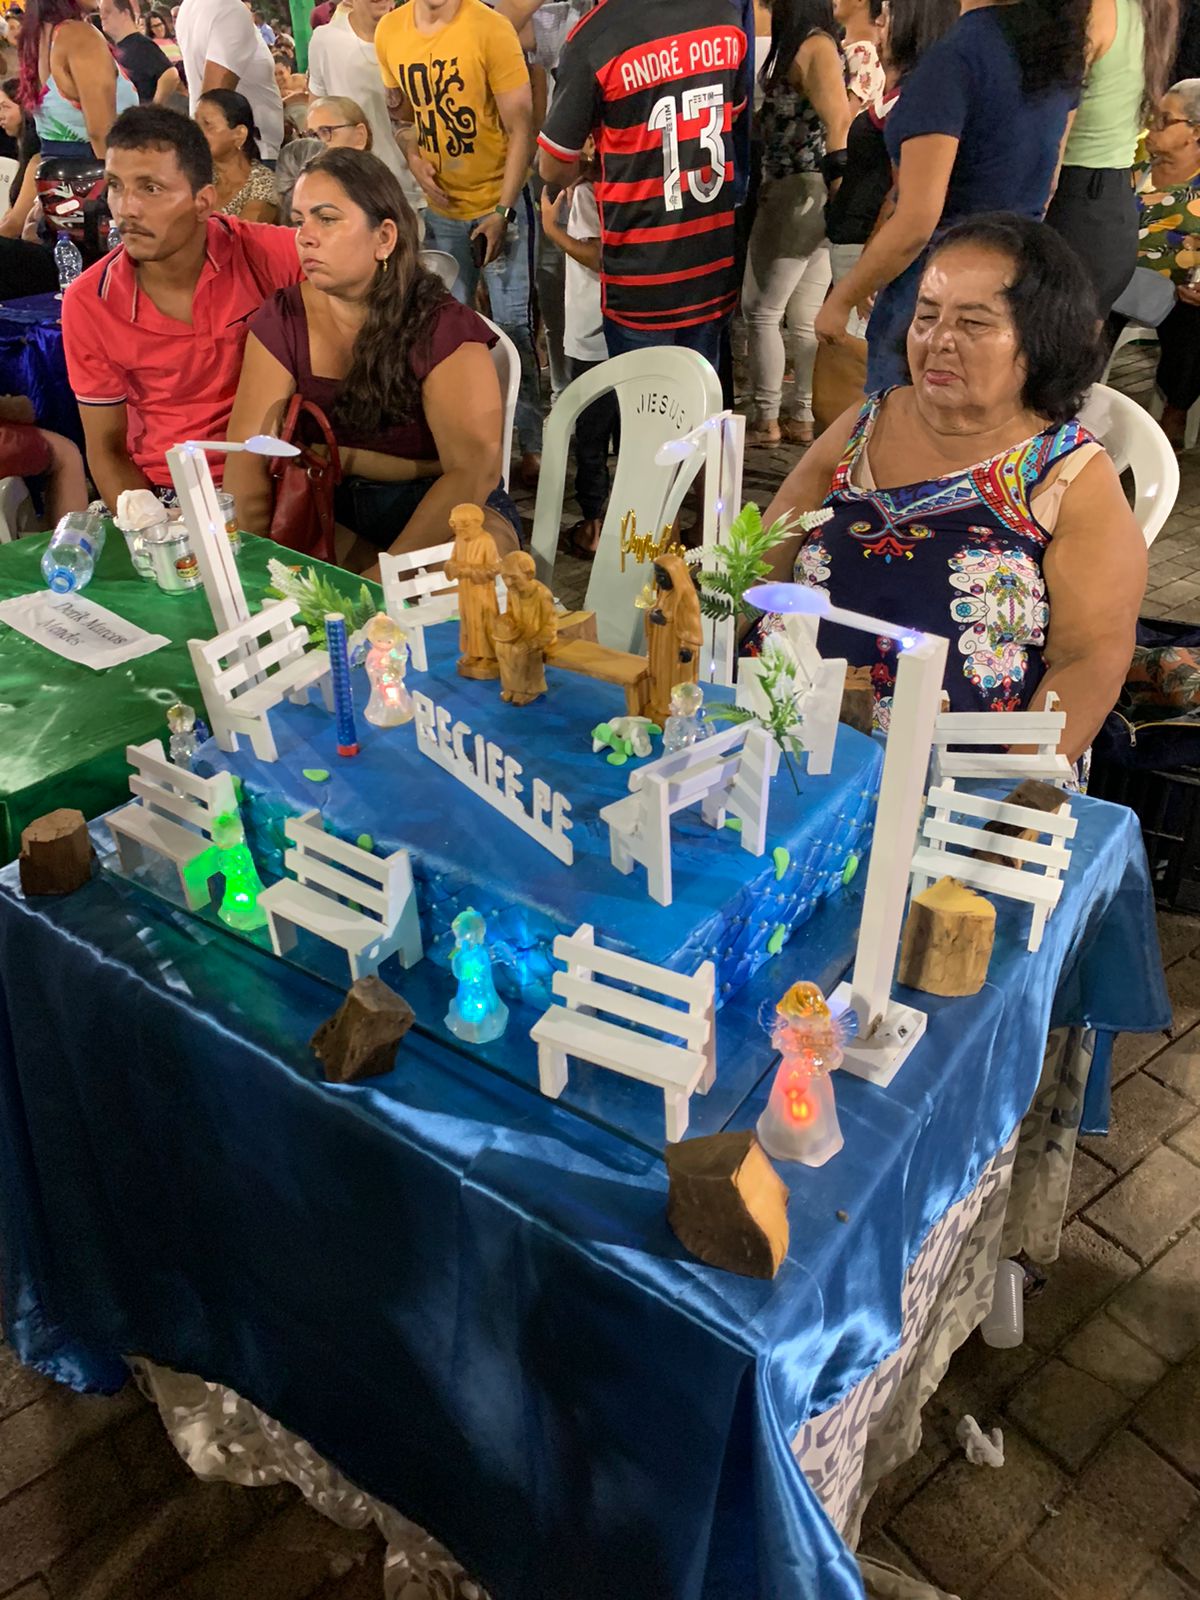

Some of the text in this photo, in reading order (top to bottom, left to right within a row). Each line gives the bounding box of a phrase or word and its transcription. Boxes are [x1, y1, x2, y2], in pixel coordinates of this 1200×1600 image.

[621, 37, 739, 91] ANDRÉ POETA
[647, 83, 726, 212] 13
[637, 393, 685, 430] JESUS
[412, 690, 574, 847] RECIFE PE
